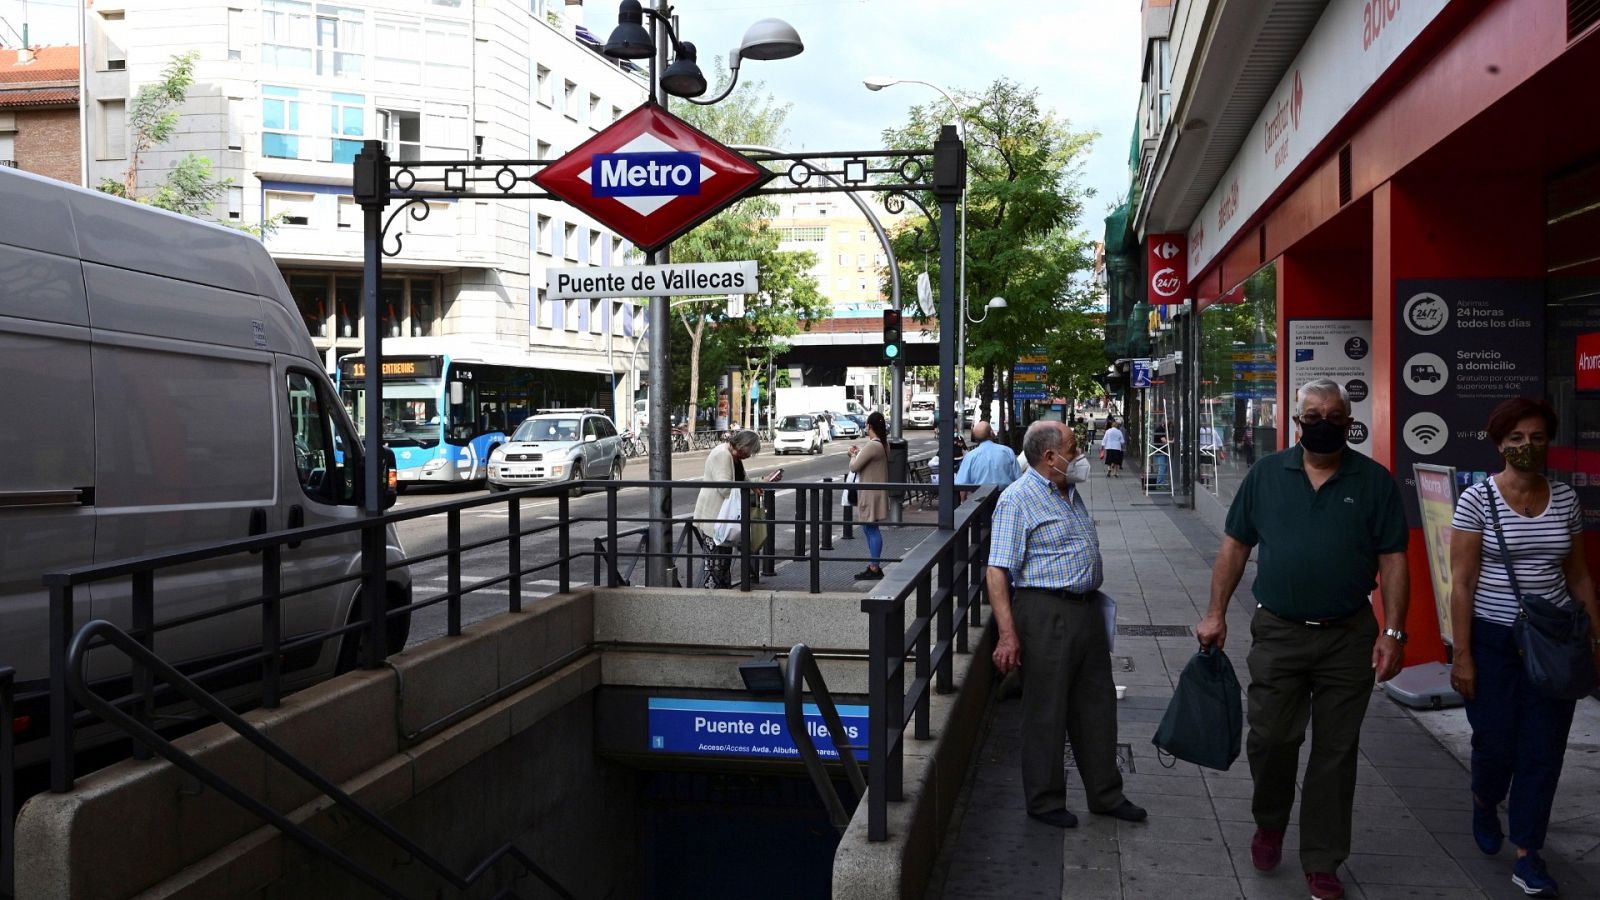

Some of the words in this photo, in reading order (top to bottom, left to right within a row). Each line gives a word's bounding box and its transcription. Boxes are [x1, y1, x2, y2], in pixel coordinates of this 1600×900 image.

[601, 159, 692, 188] Metro
[558, 273, 625, 294] Puente
[631, 271, 656, 290] de
[661, 269, 745, 290] Vallecas
[1157, 278, 1179, 288] 24/7
[1416, 308, 1437, 318] 24/7
[1456, 308, 1471, 317] 24
[1473, 307, 1504, 317] horas
[1456, 319, 1489, 328] todos
[1490, 319, 1506, 328] los
[1508, 318, 1532, 328] días
[1352, 338, 1361, 348] 3
[1456, 350, 1501, 359] Servicio
[1465, 361, 1516, 370] domicilio
[1456, 374, 1489, 382] Gratuito
[1421, 474, 1442, 494] Ahorra
[695, 716, 755, 734] Puente
[759, 719, 781, 735] de
[751, 745, 772, 753] Avda.
